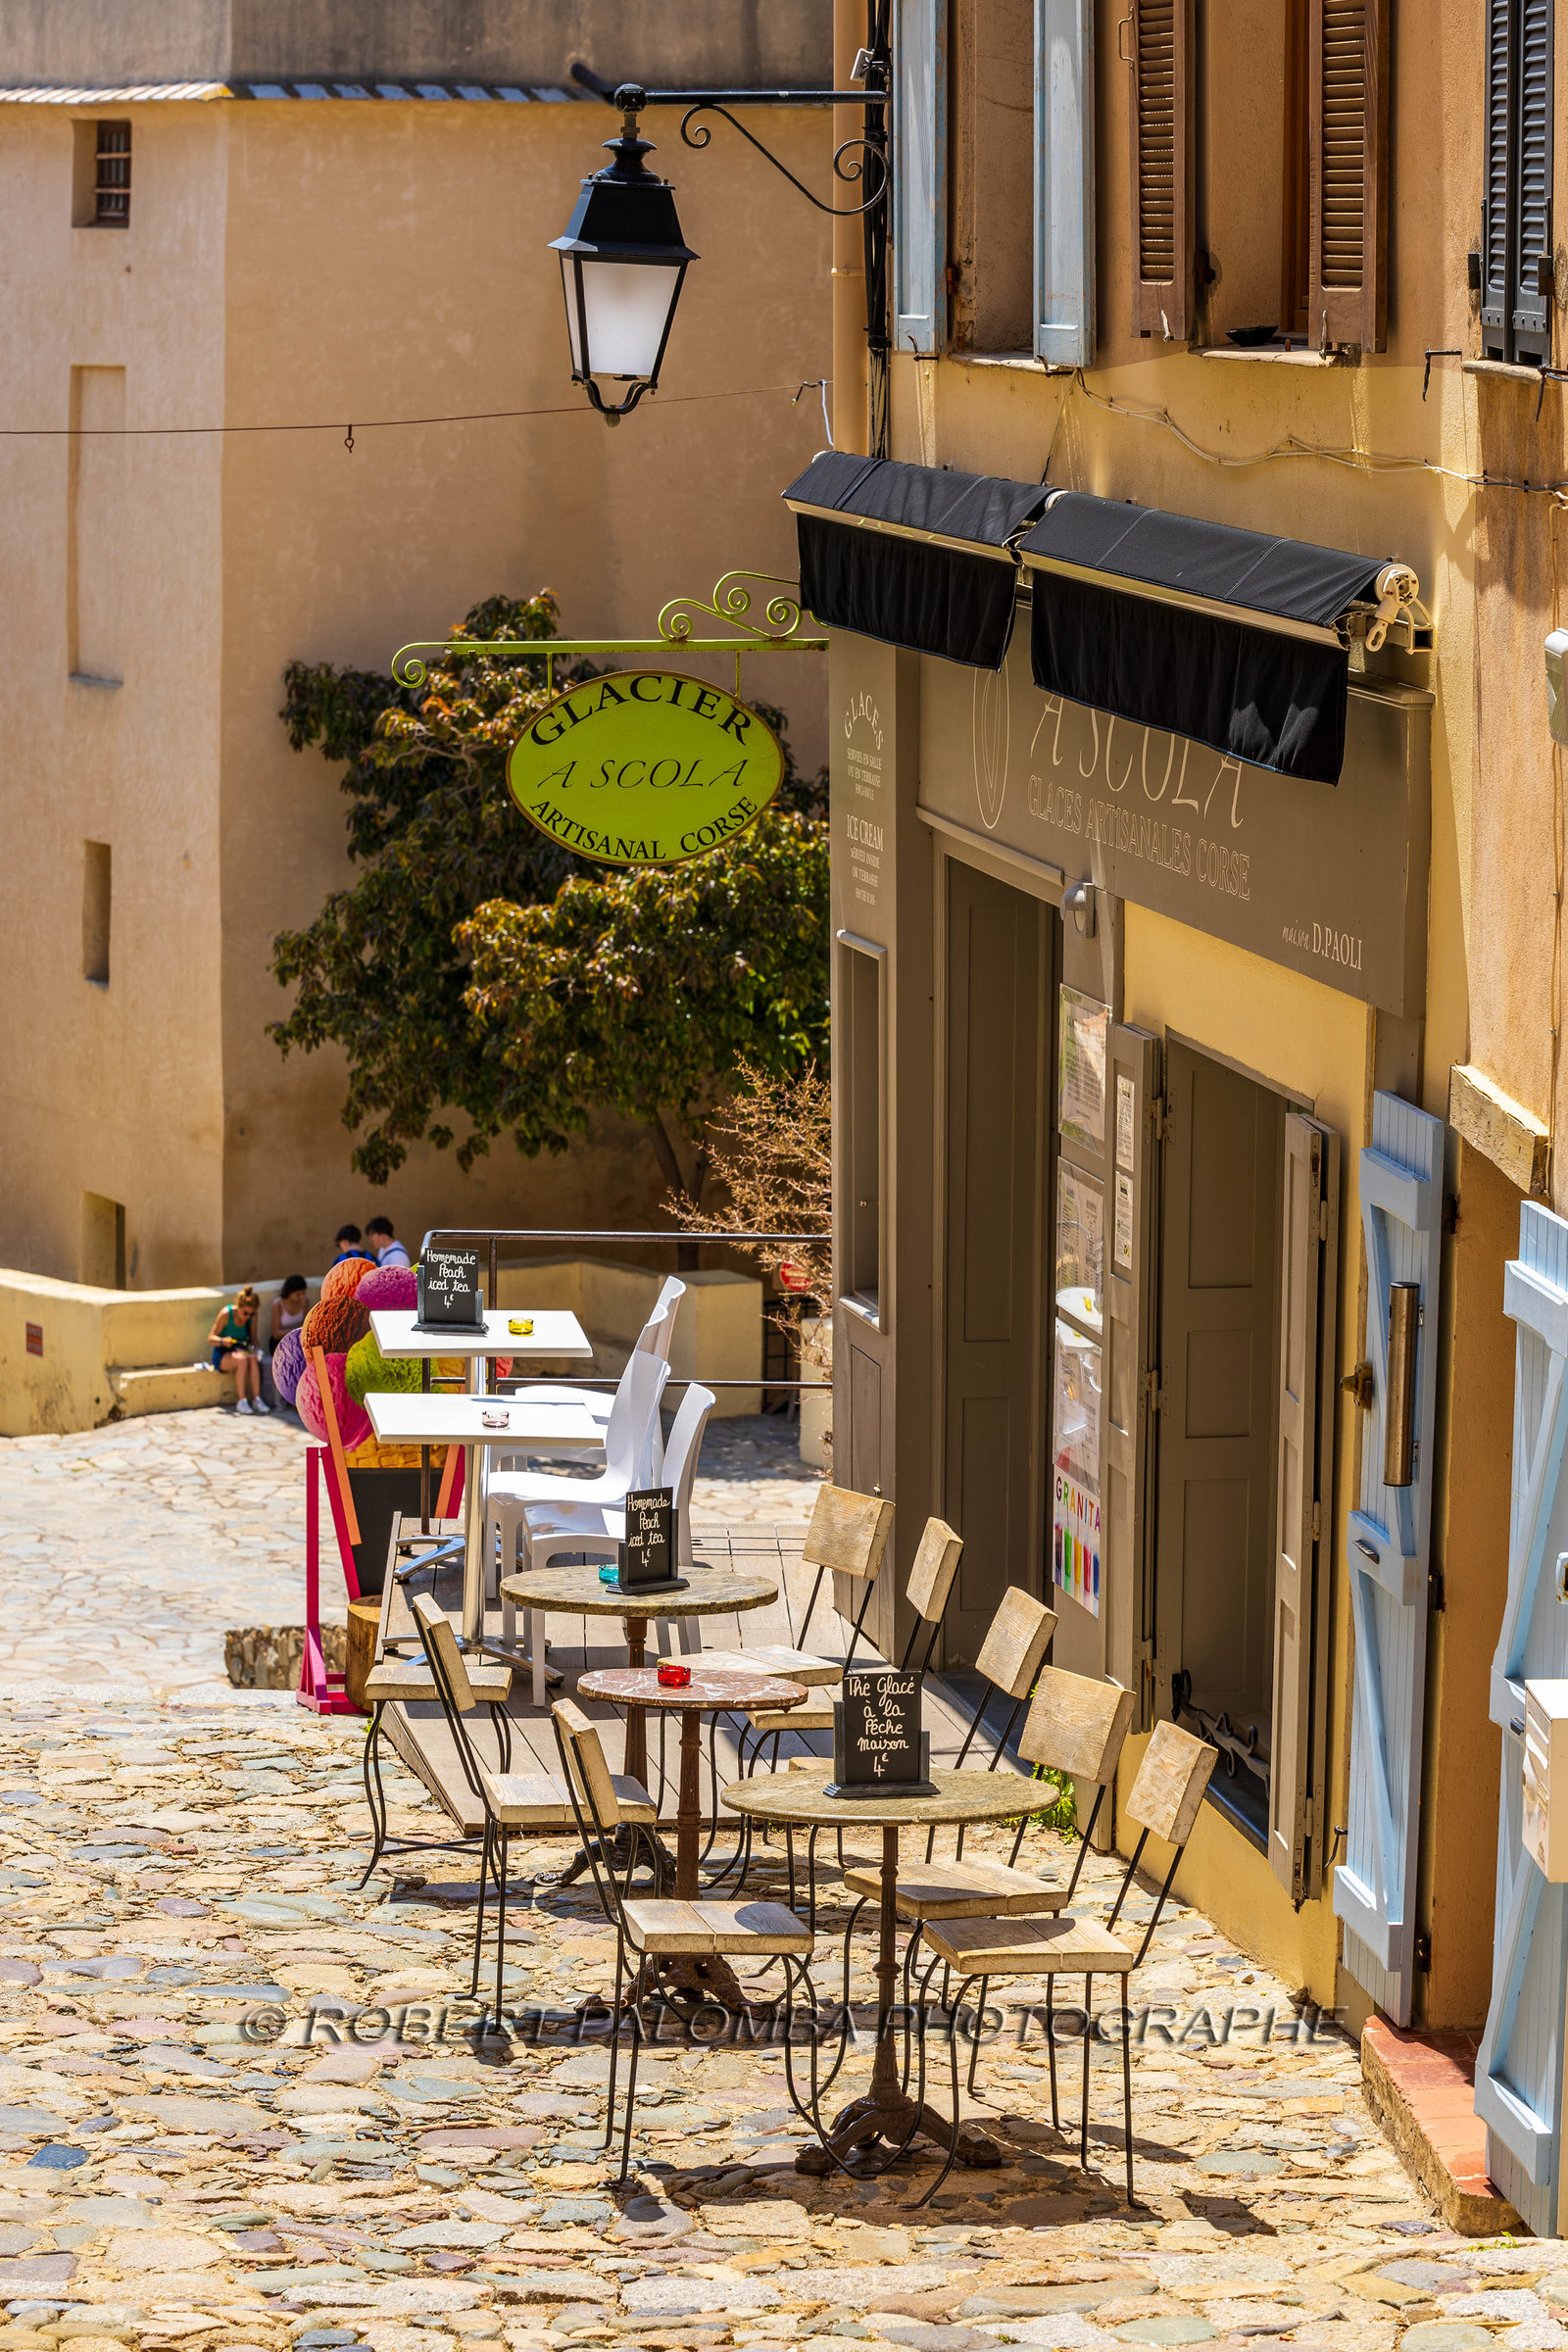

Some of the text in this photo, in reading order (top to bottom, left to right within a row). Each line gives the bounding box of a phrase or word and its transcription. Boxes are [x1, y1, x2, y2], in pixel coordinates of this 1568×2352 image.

[530, 675, 752, 747] GLACIER
[844, 691, 883, 751] GLACES
[537, 759, 750, 789] A SCOLA
[529, 796, 758, 859] ARTISANAL CORSE
[847, 813, 883, 852] ICE CREAM
[1028, 775, 1250, 901] GLACES ARTISANALES CORSE
[1282, 919, 1363, 971] maison D.PAOLI
[426, 1249, 476, 1265] Homemade
[439, 1262, 466, 1279] Peach
[428, 1277, 471, 1293] iced tea
[627, 1493, 671, 1511] Homemade
[1055, 1475, 1101, 1534] GRANITA
[639, 1510, 661, 1530] Peach
[628, 1531, 665, 1547] iced tea
[844, 1674, 915, 1707] Thé Glacé
[863, 1698, 906, 1718] à la
[865, 1718, 904, 1736] Pêche
